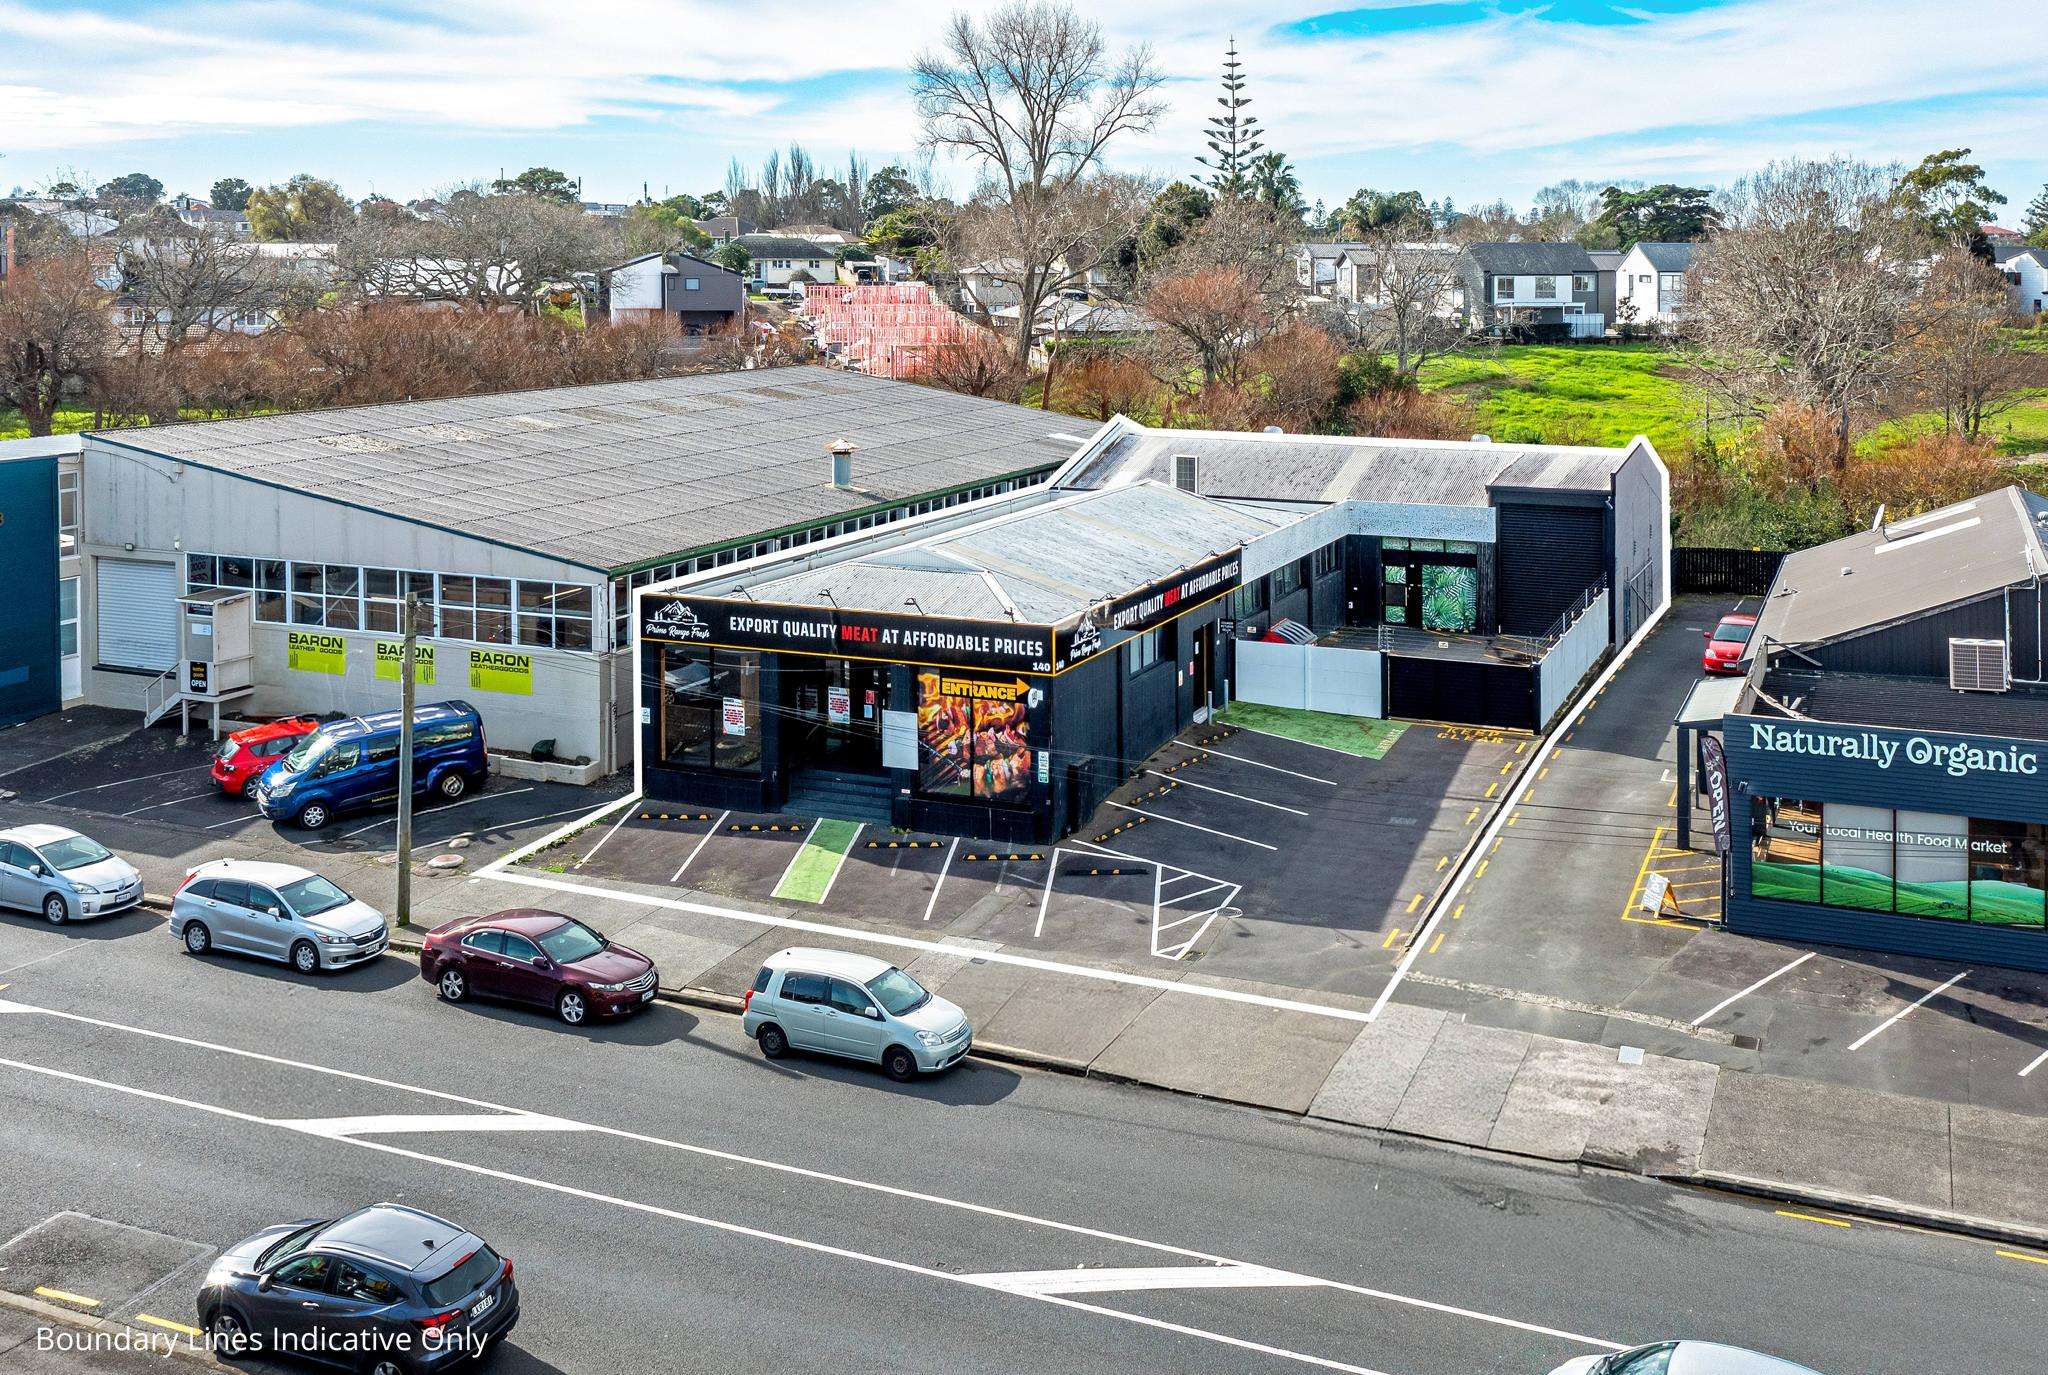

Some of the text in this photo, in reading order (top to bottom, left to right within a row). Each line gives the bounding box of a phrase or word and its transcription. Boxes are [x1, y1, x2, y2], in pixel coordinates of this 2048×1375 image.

[1113, 560, 1239, 630] EXPORT QUALITY MEAT AT AFFORDABLE PRICES
[288, 632, 343, 649] BARON
[645, 623, 711, 640] Prime Range Fresh
[729, 616, 1043, 657] EXPORT QUALITY MEAT AT AFFORDABLE PRICES
[289, 643, 343, 655] LEATHER GOODS
[470, 650, 529, 668] BARON
[1032, 661, 1050, 672] 140
[191, 679, 207, 688] OPEN
[941, 682, 1016, 700] ENTRANCE
[1749, 723, 2038, 777] Naturally Organic
[1709, 770, 1726, 834] OPEN
[1788, 820, 2008, 854] Your Local Health Food Market
